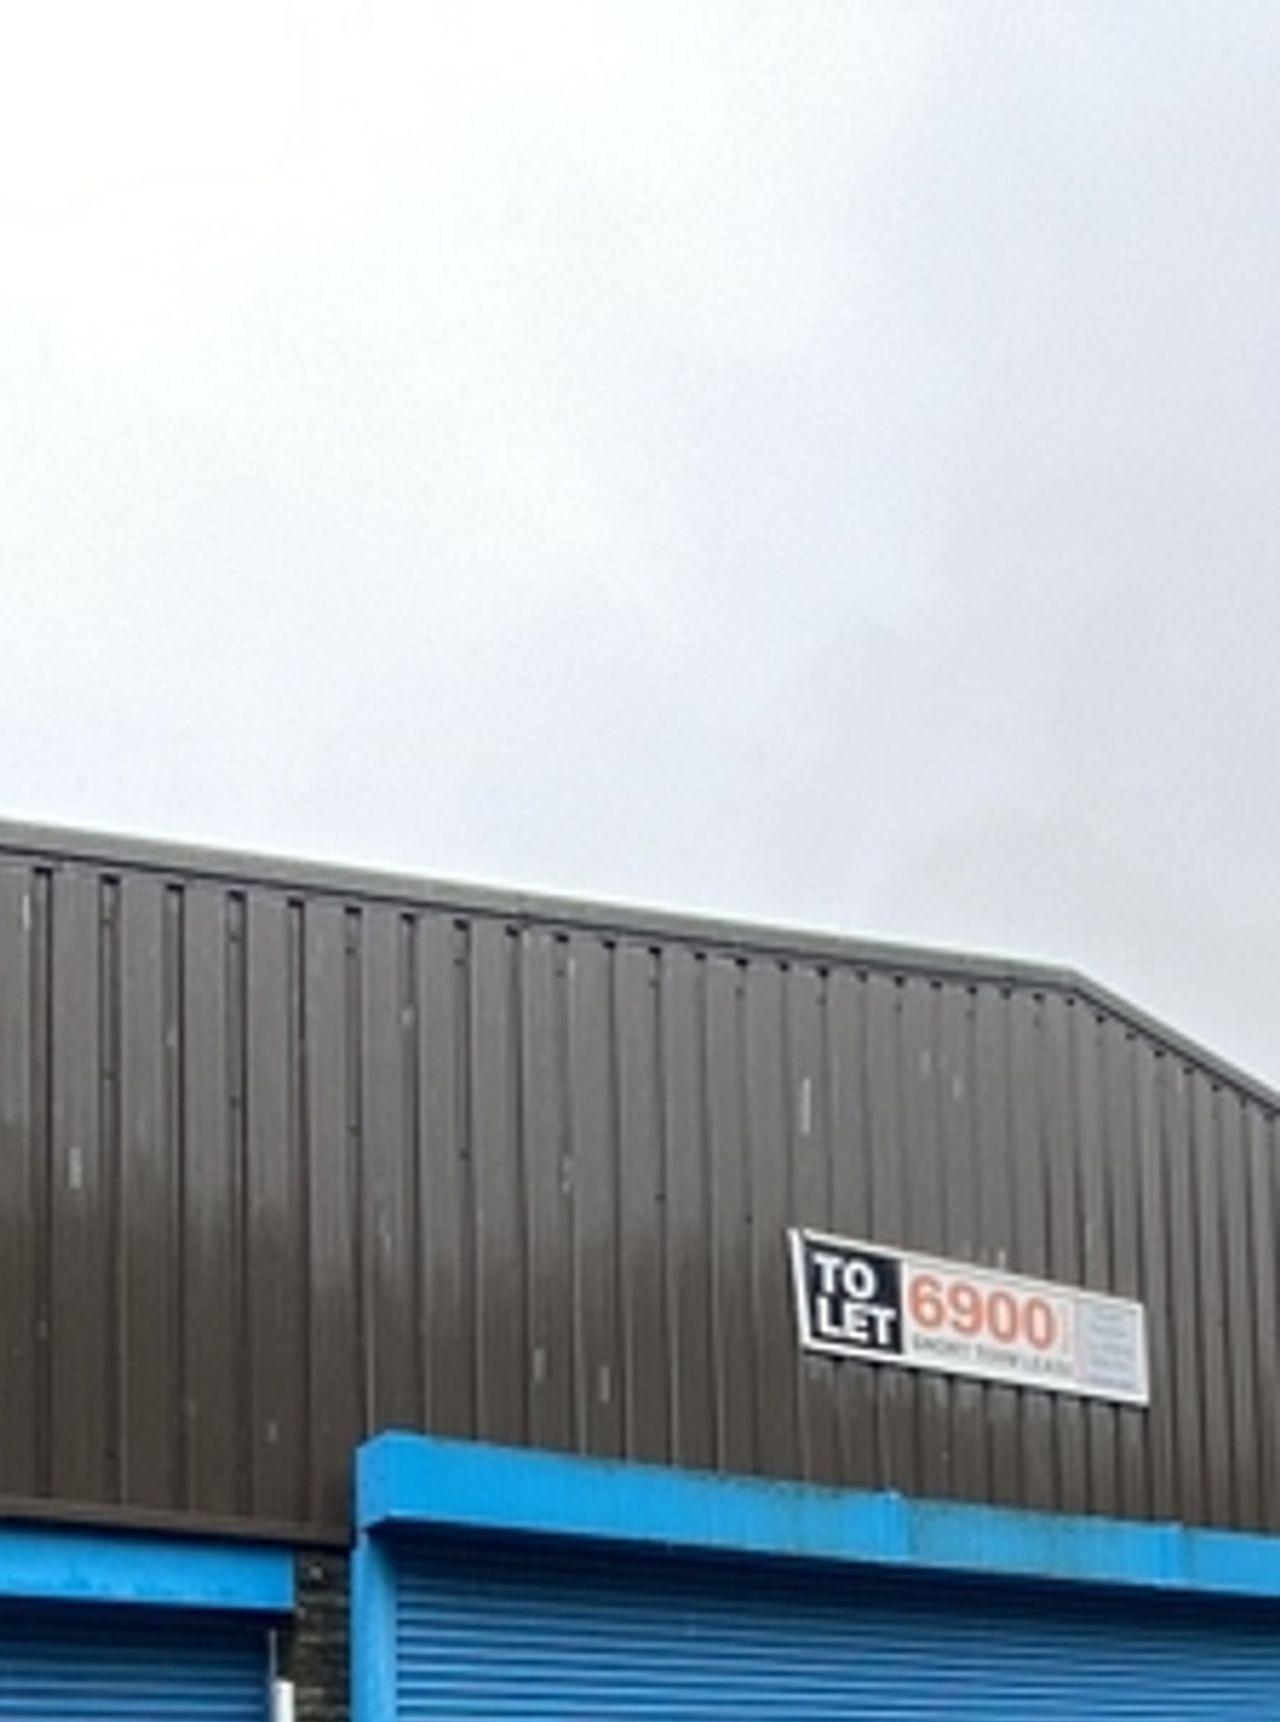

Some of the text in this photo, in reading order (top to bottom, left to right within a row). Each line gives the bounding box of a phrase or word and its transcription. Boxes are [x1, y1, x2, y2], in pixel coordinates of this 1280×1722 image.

[813, 1252, 876, 1300] TO
[816, 1295, 897, 1345] LET
[909, 1273, 1058, 1351] 6900
